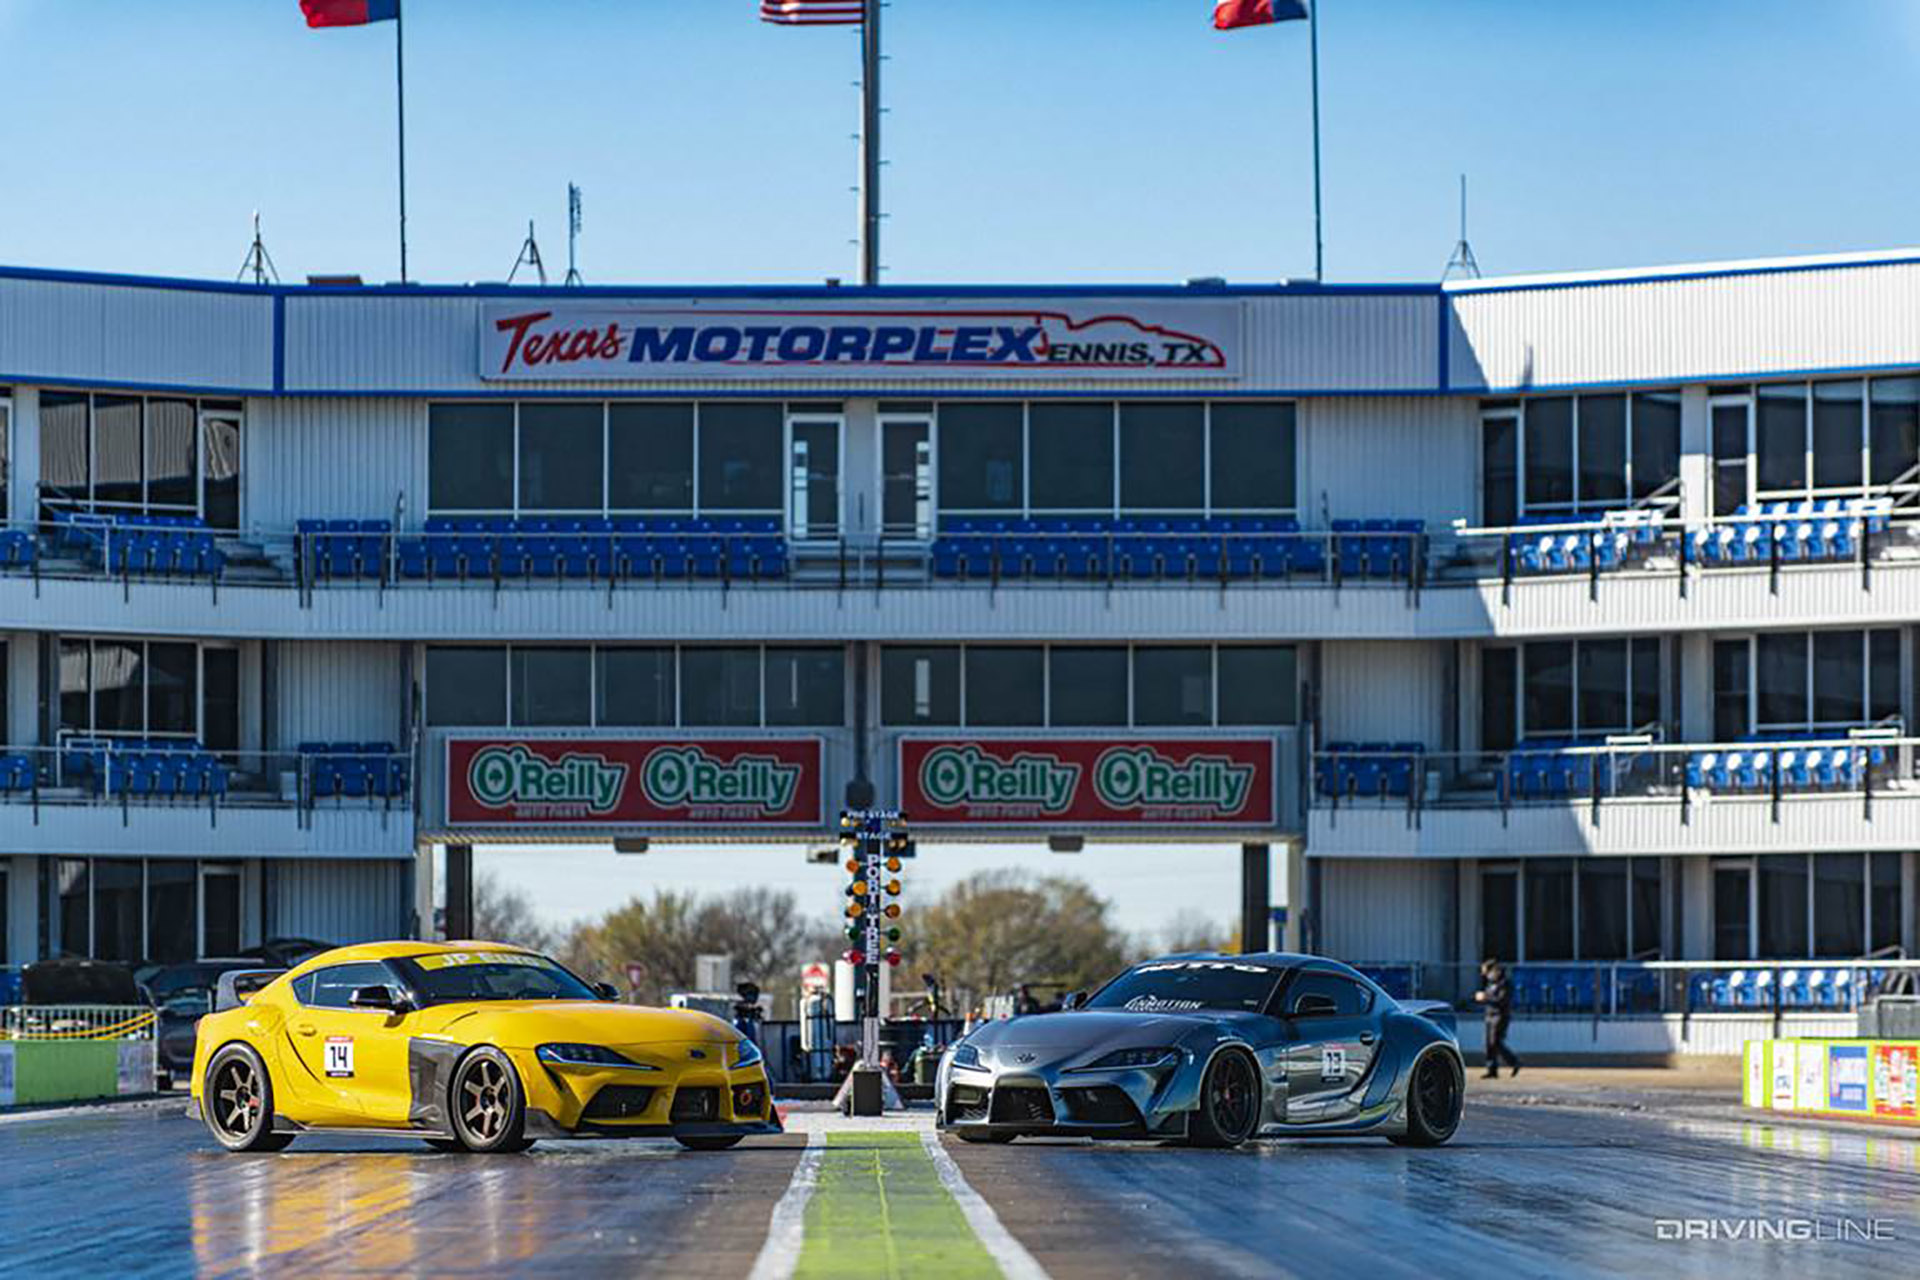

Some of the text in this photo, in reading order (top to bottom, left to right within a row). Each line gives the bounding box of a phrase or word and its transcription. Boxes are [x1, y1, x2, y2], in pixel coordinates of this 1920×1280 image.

[496, 311, 1210, 373] Texas MOTORPLEX ENNIS, TX
[471, 746, 627, 811] O'Reilly
[645, 746, 799, 811] O'Reilly
[922, 746, 1079, 811] O'Reilly
[1096, 746, 1251, 811] O'Reilly
[330, 1045, 347, 1068] 14
